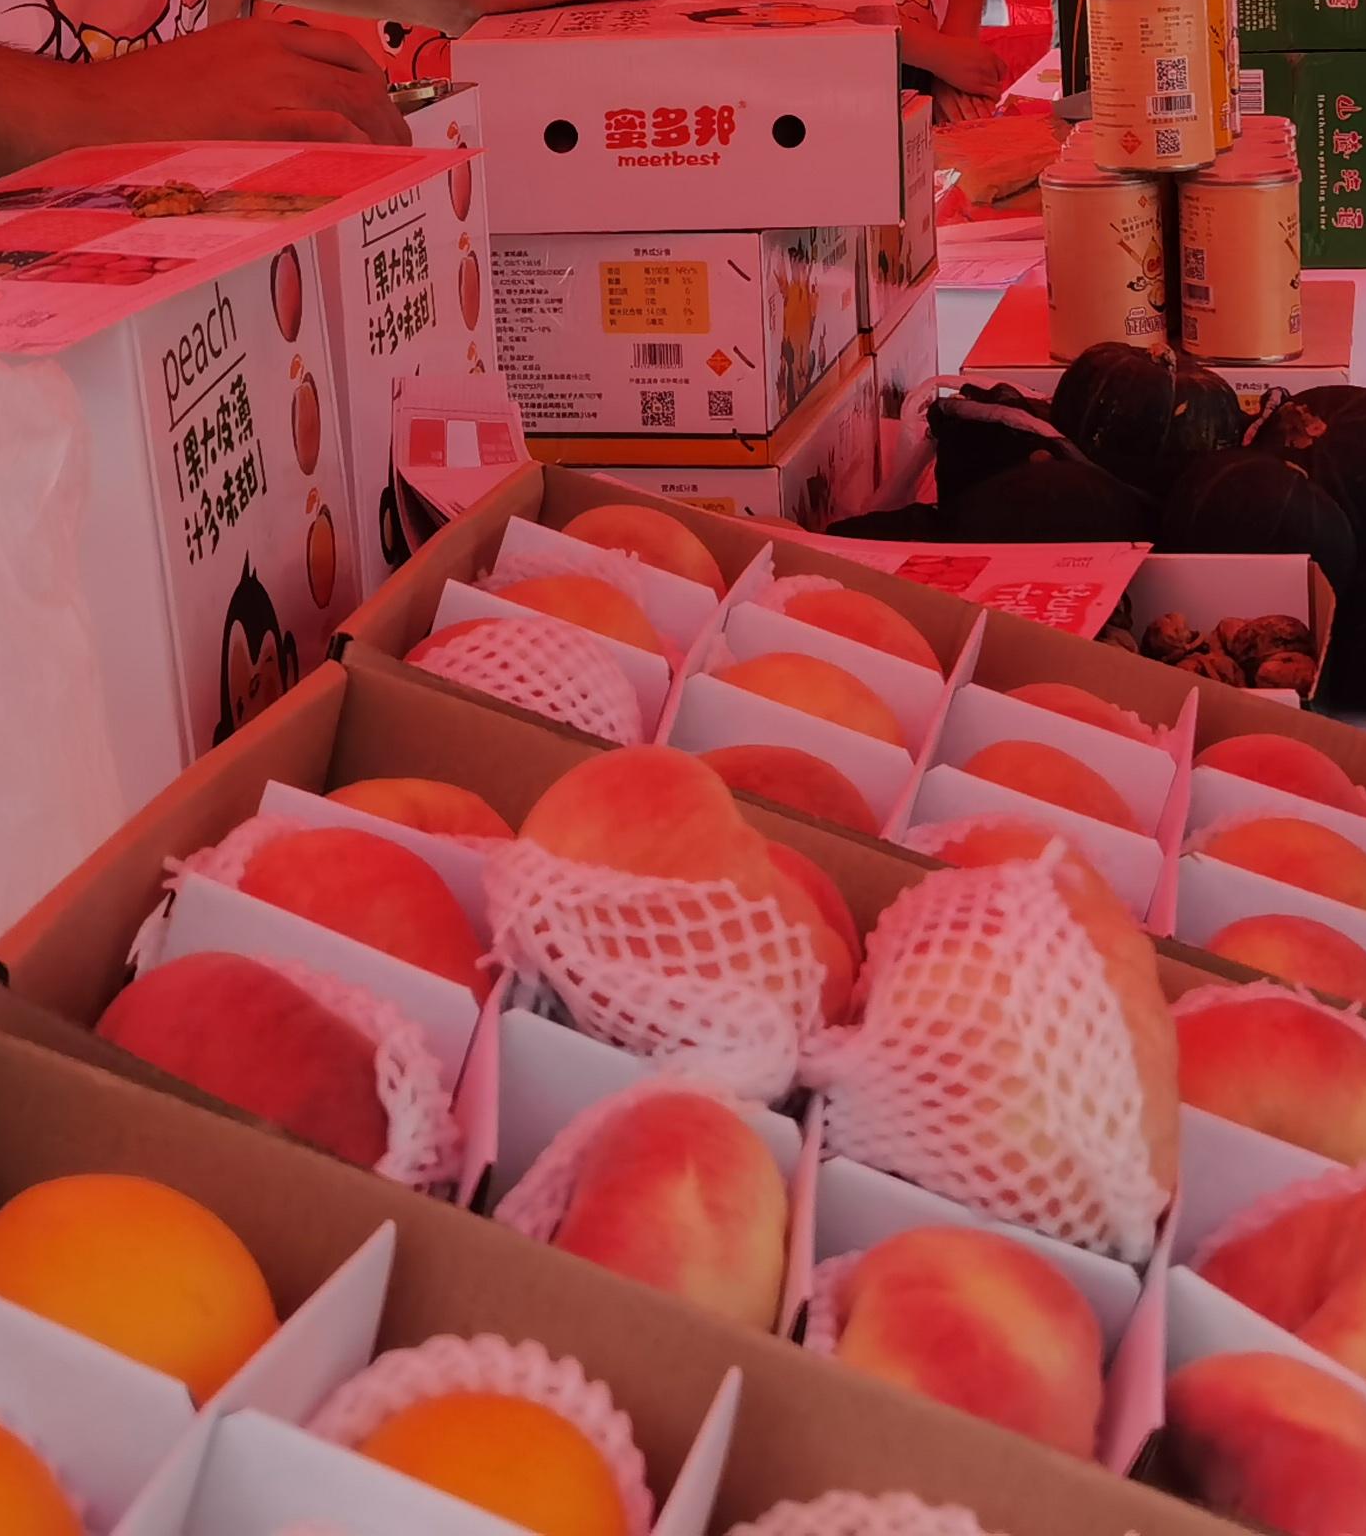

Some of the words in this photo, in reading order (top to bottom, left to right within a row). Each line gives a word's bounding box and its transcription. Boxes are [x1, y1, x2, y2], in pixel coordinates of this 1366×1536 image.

[604, 105, 736, 149] 蜜多邦
[617, 150, 721, 167] meetbest
[161, 281, 237, 427] peach
